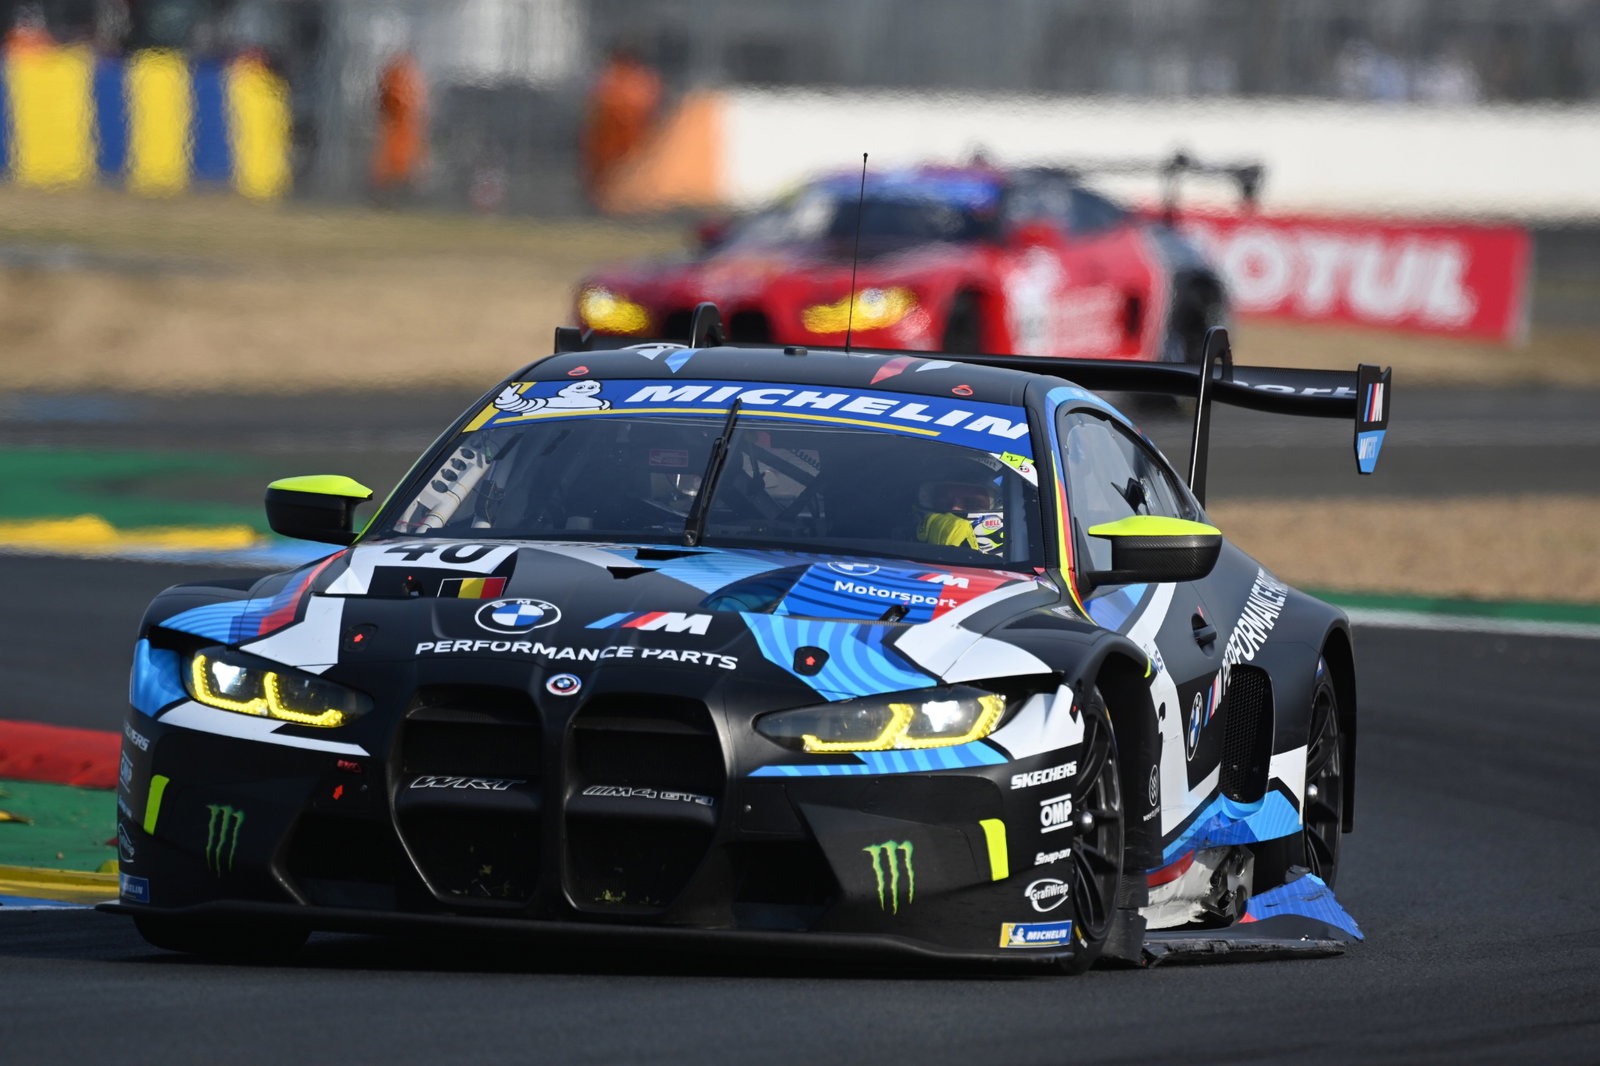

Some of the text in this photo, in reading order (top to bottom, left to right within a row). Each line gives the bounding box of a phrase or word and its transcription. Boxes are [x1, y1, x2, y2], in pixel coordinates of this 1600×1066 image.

[624, 385, 1029, 440] MICHELIN
[984, 519, 1001, 527] BELL
[833, 580, 958, 608] Motorsport
[415, 639, 739, 670] PERFORMANCE PARTS
[409, 775, 527, 791] WRT
[1010, 760, 1077, 790] SKECHERS
[1040, 799, 1073, 827] OMP
[1034, 848, 1071, 866] Snap-on
[1029, 883, 1069, 901] GrafiWrap
[1026, 929, 1068, 941] MICHELIN
